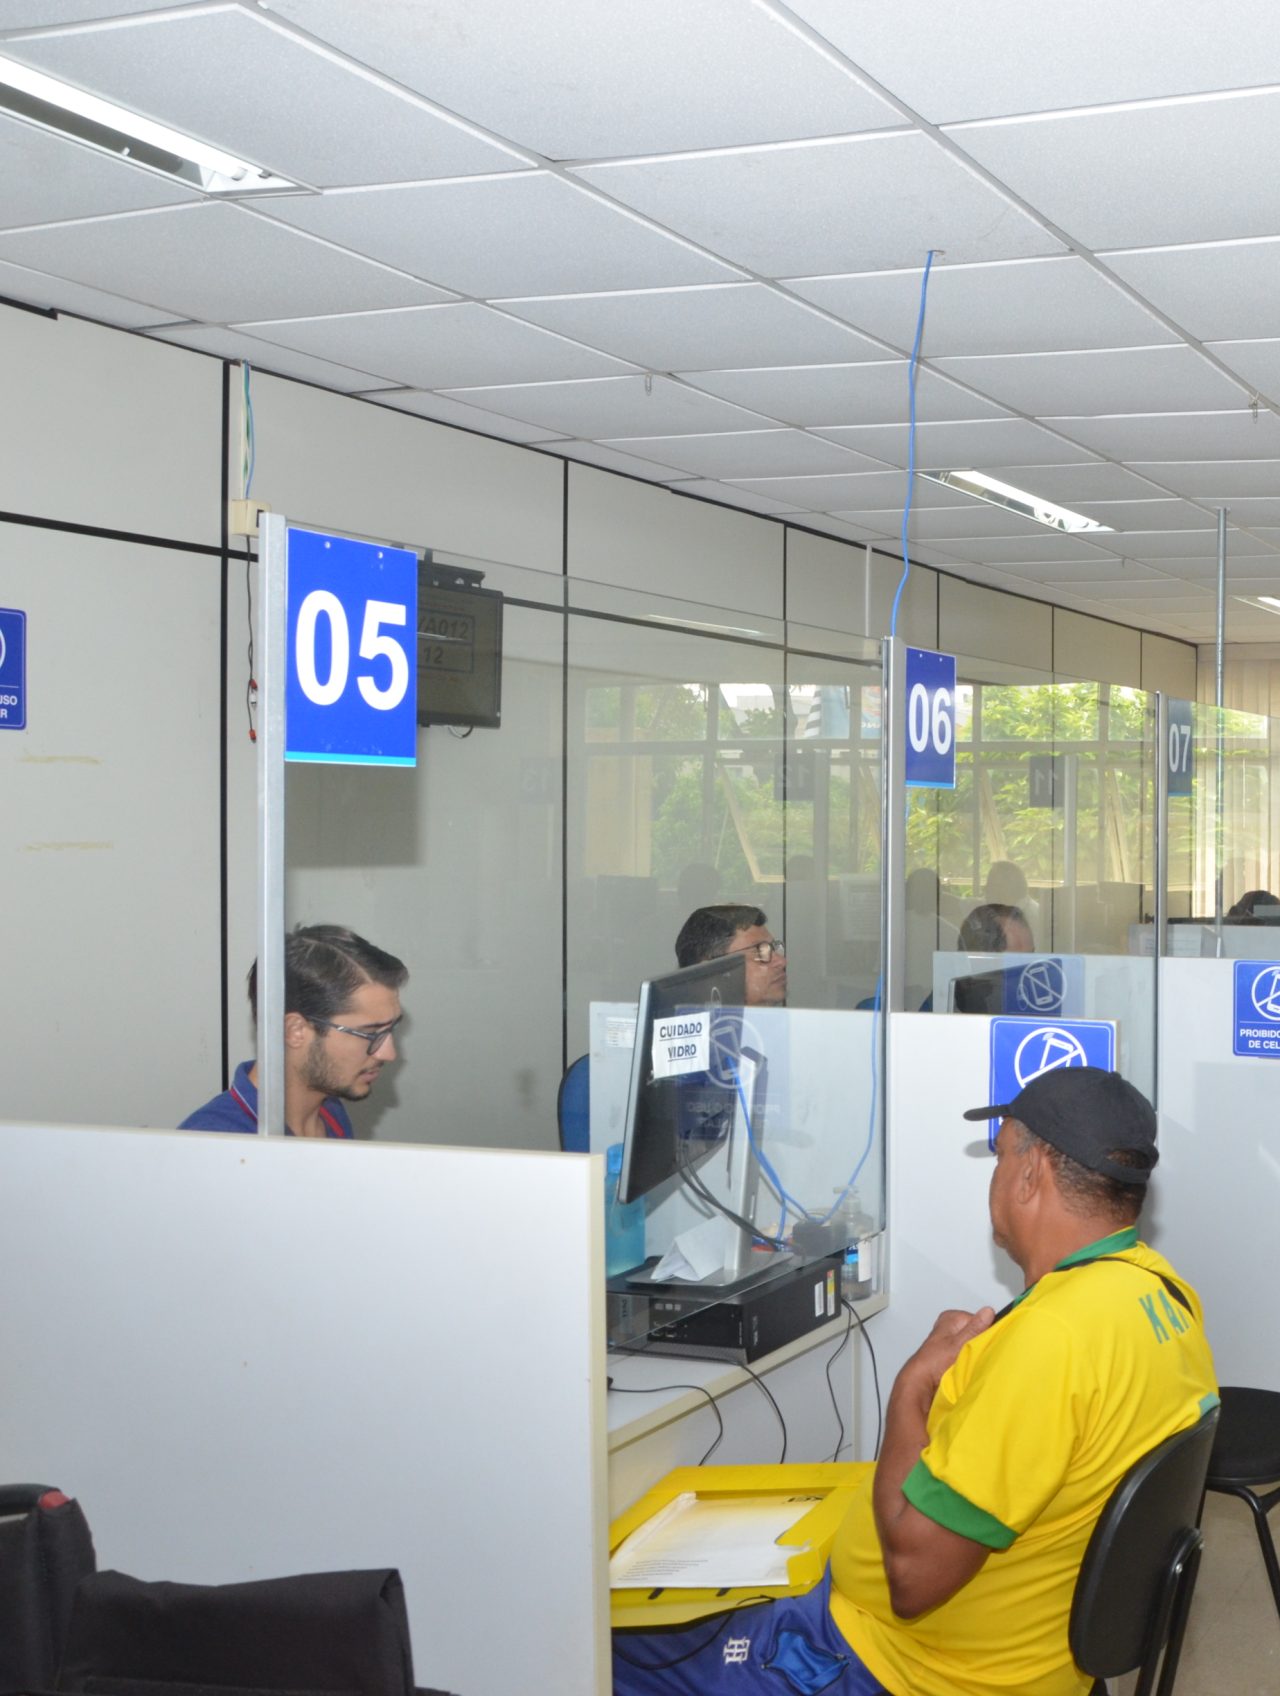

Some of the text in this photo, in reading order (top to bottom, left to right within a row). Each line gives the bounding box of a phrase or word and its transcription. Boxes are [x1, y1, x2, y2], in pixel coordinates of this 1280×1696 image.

[296, 589, 409, 711] 05
[909, 683, 952, 755] 06
[1169, 723, 1191, 773] 07
[659, 1021, 703, 1039] CUIDADO
[667, 1043, 697, 1059] VIDRO
[1248, 1039, 1261, 1049] DE
[1138, 1288, 1190, 1345] KA
